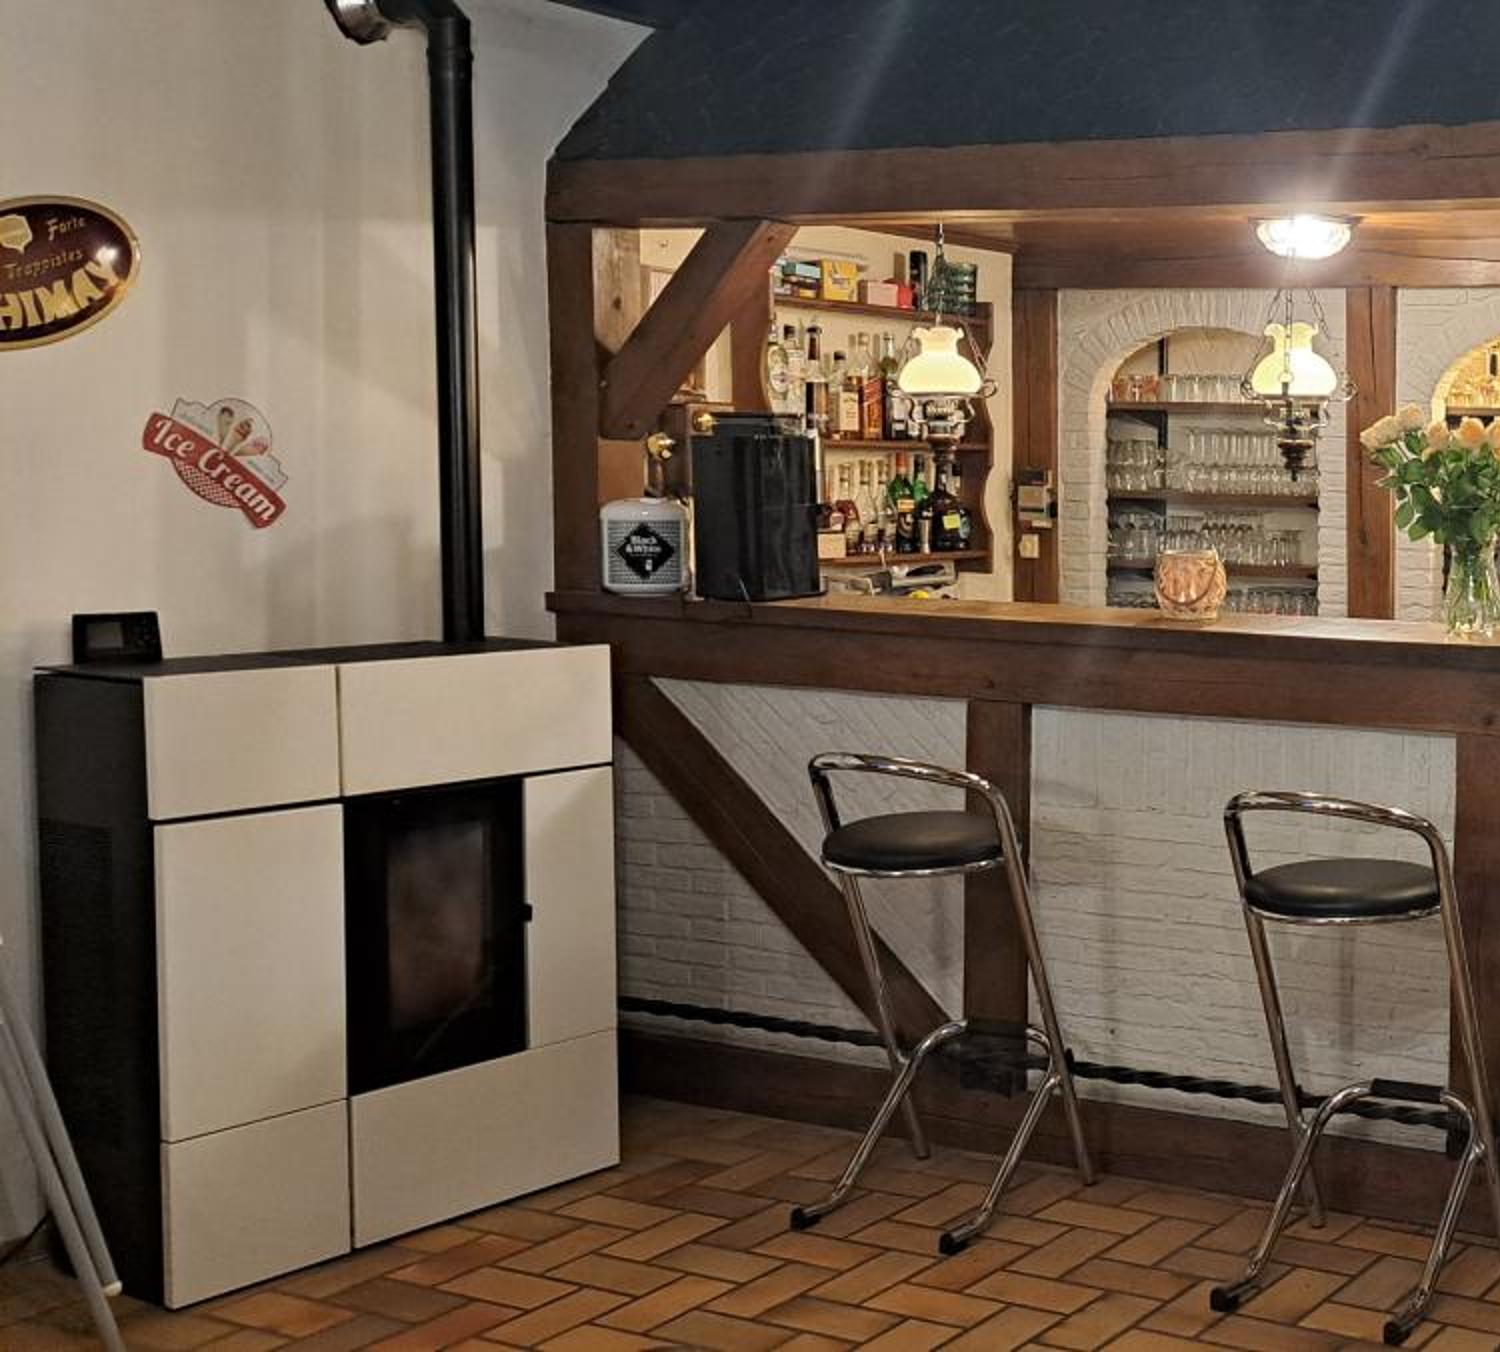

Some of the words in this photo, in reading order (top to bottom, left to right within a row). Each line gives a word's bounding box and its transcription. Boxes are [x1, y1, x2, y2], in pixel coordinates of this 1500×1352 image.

[47, 216, 87, 241] Forte
[0, 247, 122, 331] HIMAY
[4, 249, 84, 280] Trappistes
[153, 419, 196, 458] Ice
[197, 448, 278, 521] Cream
